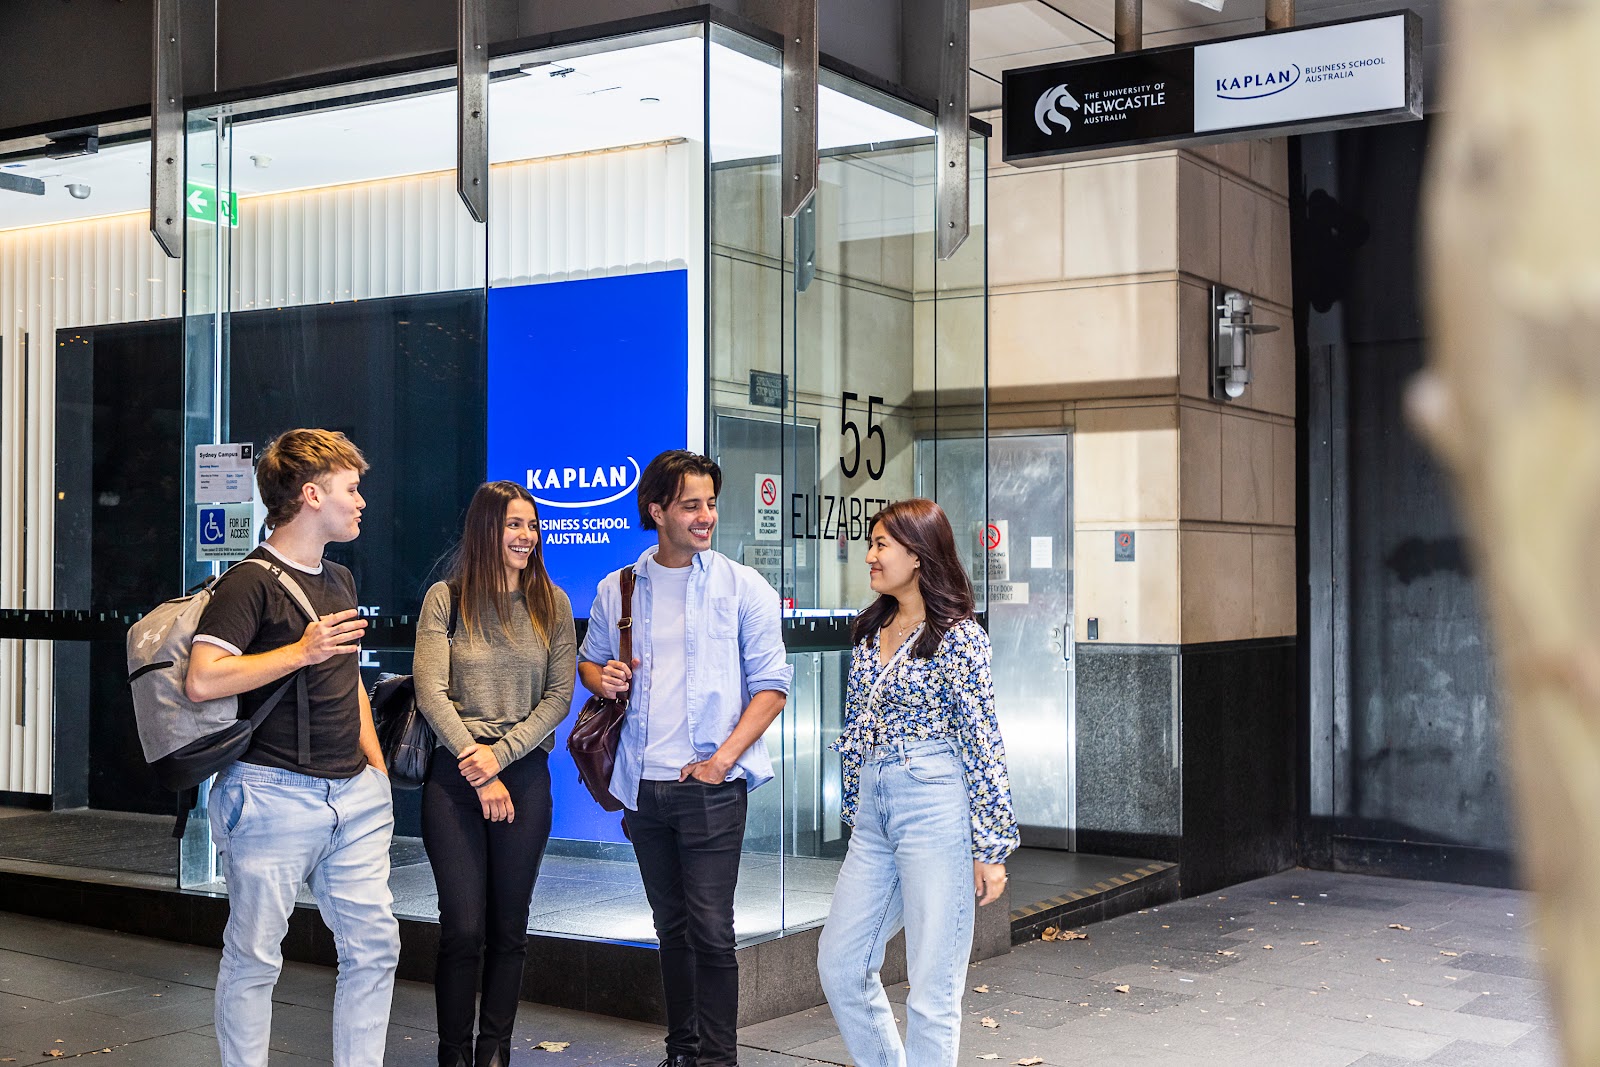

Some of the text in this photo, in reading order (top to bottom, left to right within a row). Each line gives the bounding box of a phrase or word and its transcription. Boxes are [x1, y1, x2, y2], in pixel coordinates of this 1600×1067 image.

[1305, 57, 1386, 74] BUSINESS SCHOOL
[1216, 70, 1290, 92] KAPLAN
[1305, 70, 1354, 83] AUSTRALIA
[1084, 82, 1165, 100] THE UNIVERSITY OF
[1084, 92, 1166, 115] NEWCASTLE
[1084, 113, 1127, 124] AUSTRALIA
[839, 391, 886, 481] 55
[526, 465, 627, 490] KAPLAN
[230, 518, 250, 527] FOR LIFT
[540, 518, 630, 531] SINESS SCHOOL
[792, 493, 890, 541] ELIZABE
[231, 529, 249, 538] ACCESS
[546, 532, 610, 544] AUSTRALIA
[1000, 584, 1014, 593] DOOR
